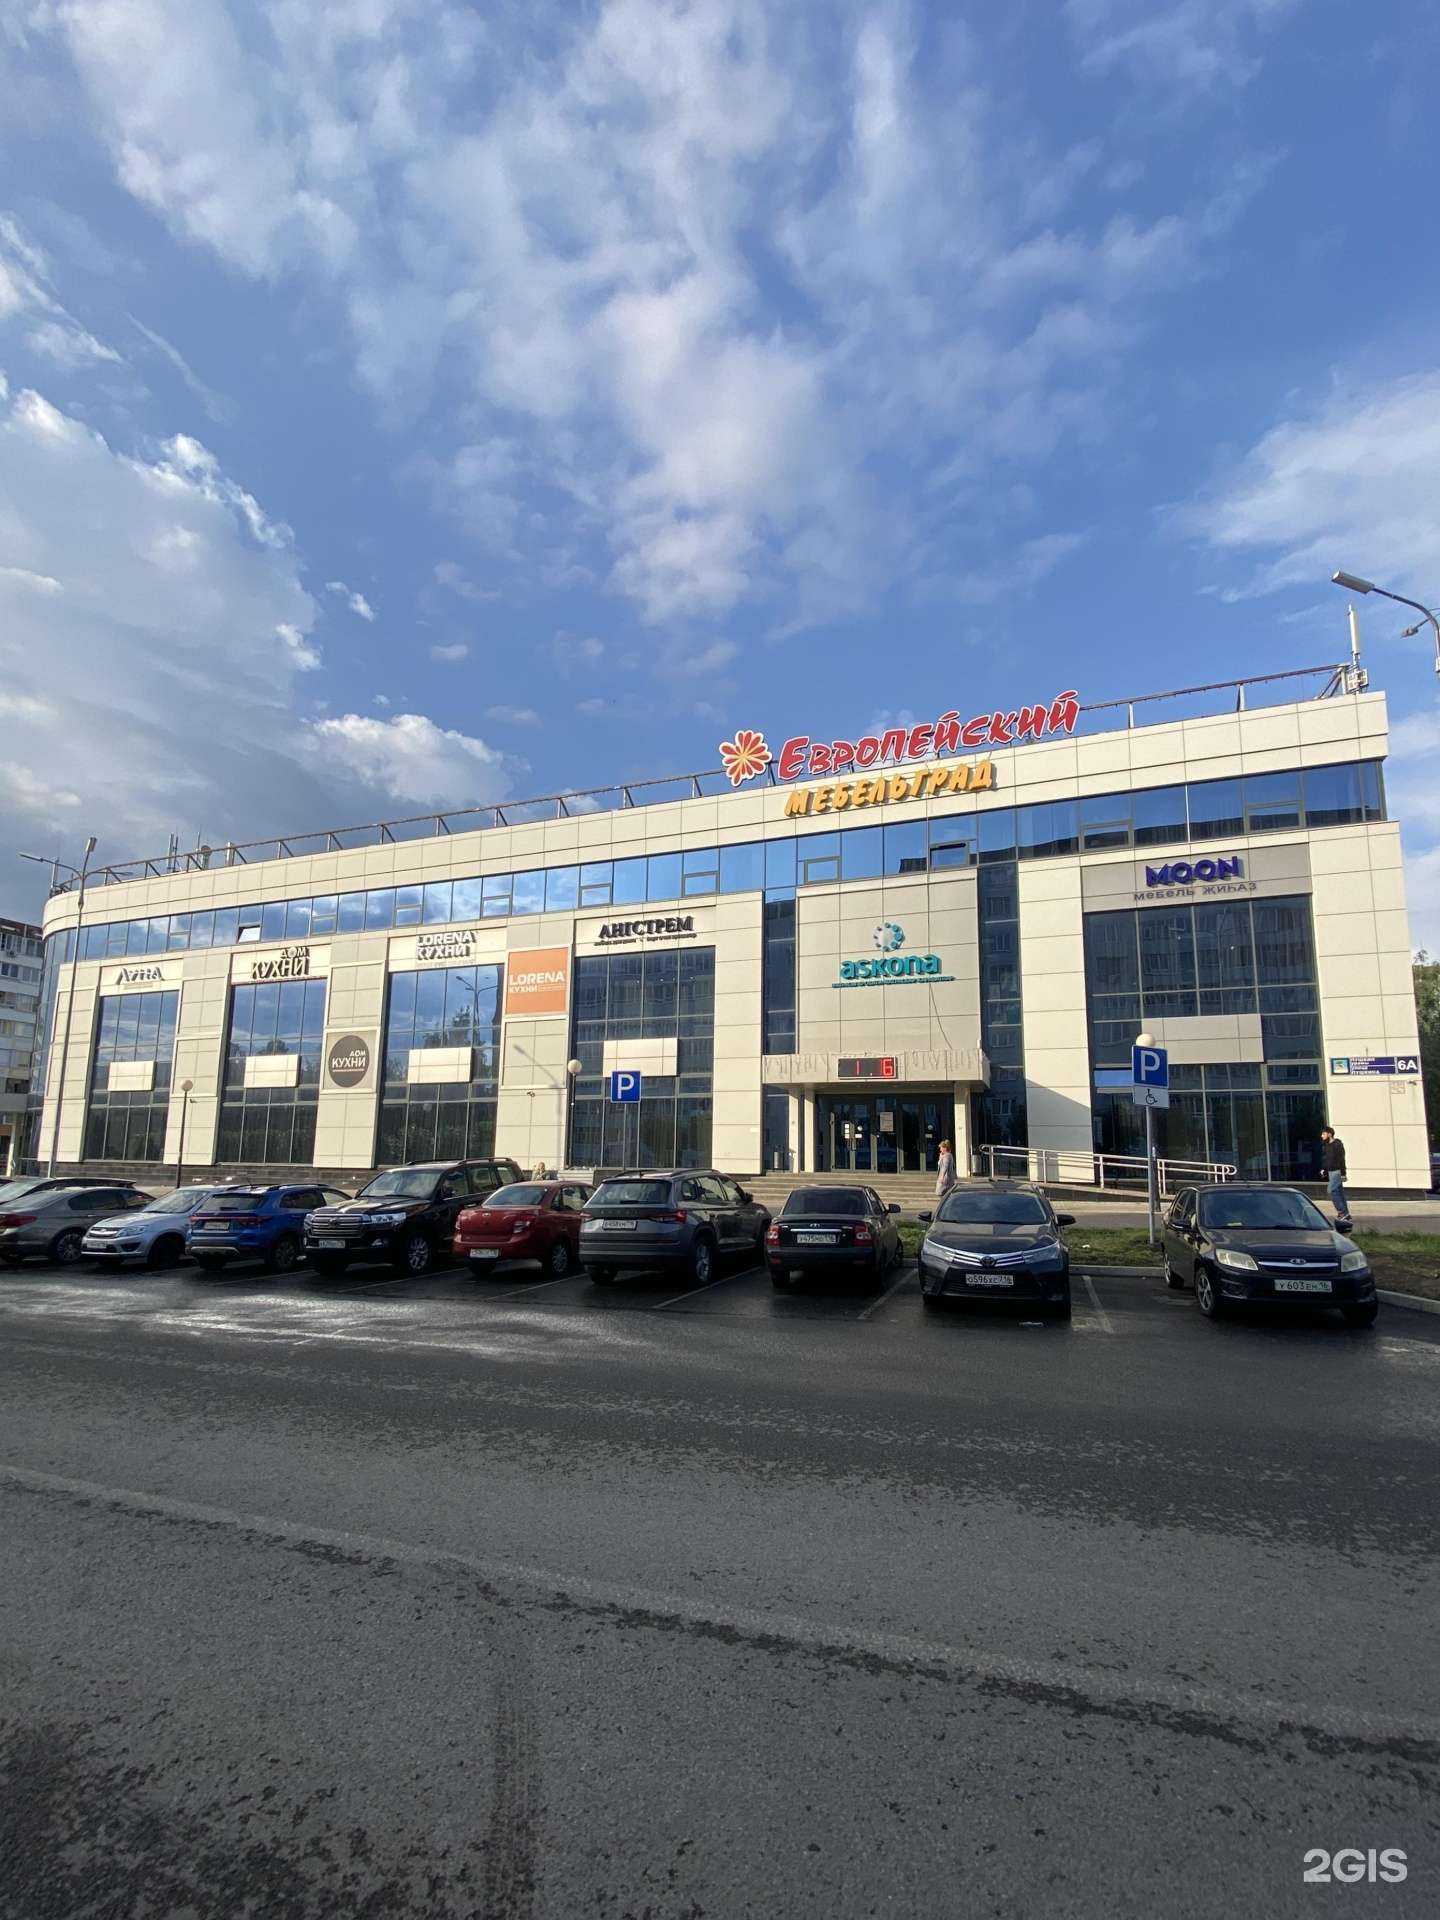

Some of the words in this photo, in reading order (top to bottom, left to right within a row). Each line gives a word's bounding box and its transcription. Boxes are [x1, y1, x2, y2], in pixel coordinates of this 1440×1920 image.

[784, 760, 997, 817] МЕБЕЛЬГРАД
[1145, 856, 1241, 888] MOON
[599, 915, 694, 939] АНГСТРЕМ
[416, 931, 477, 946] LORENA
[280, 946, 310, 960] ДОМ
[416, 942, 470, 960] КУХНИ
[252, 958, 309, 979] КУХНИ
[840, 953, 942, 980] askona
[509, 970, 566, 986] LORENA
[331, 1056, 366, 1069] КУХНИ
[350, 1049, 366, 1057] ДОМ
[1140, 1050, 1160, 1080] P
[617, 1073, 635, 1100] P
